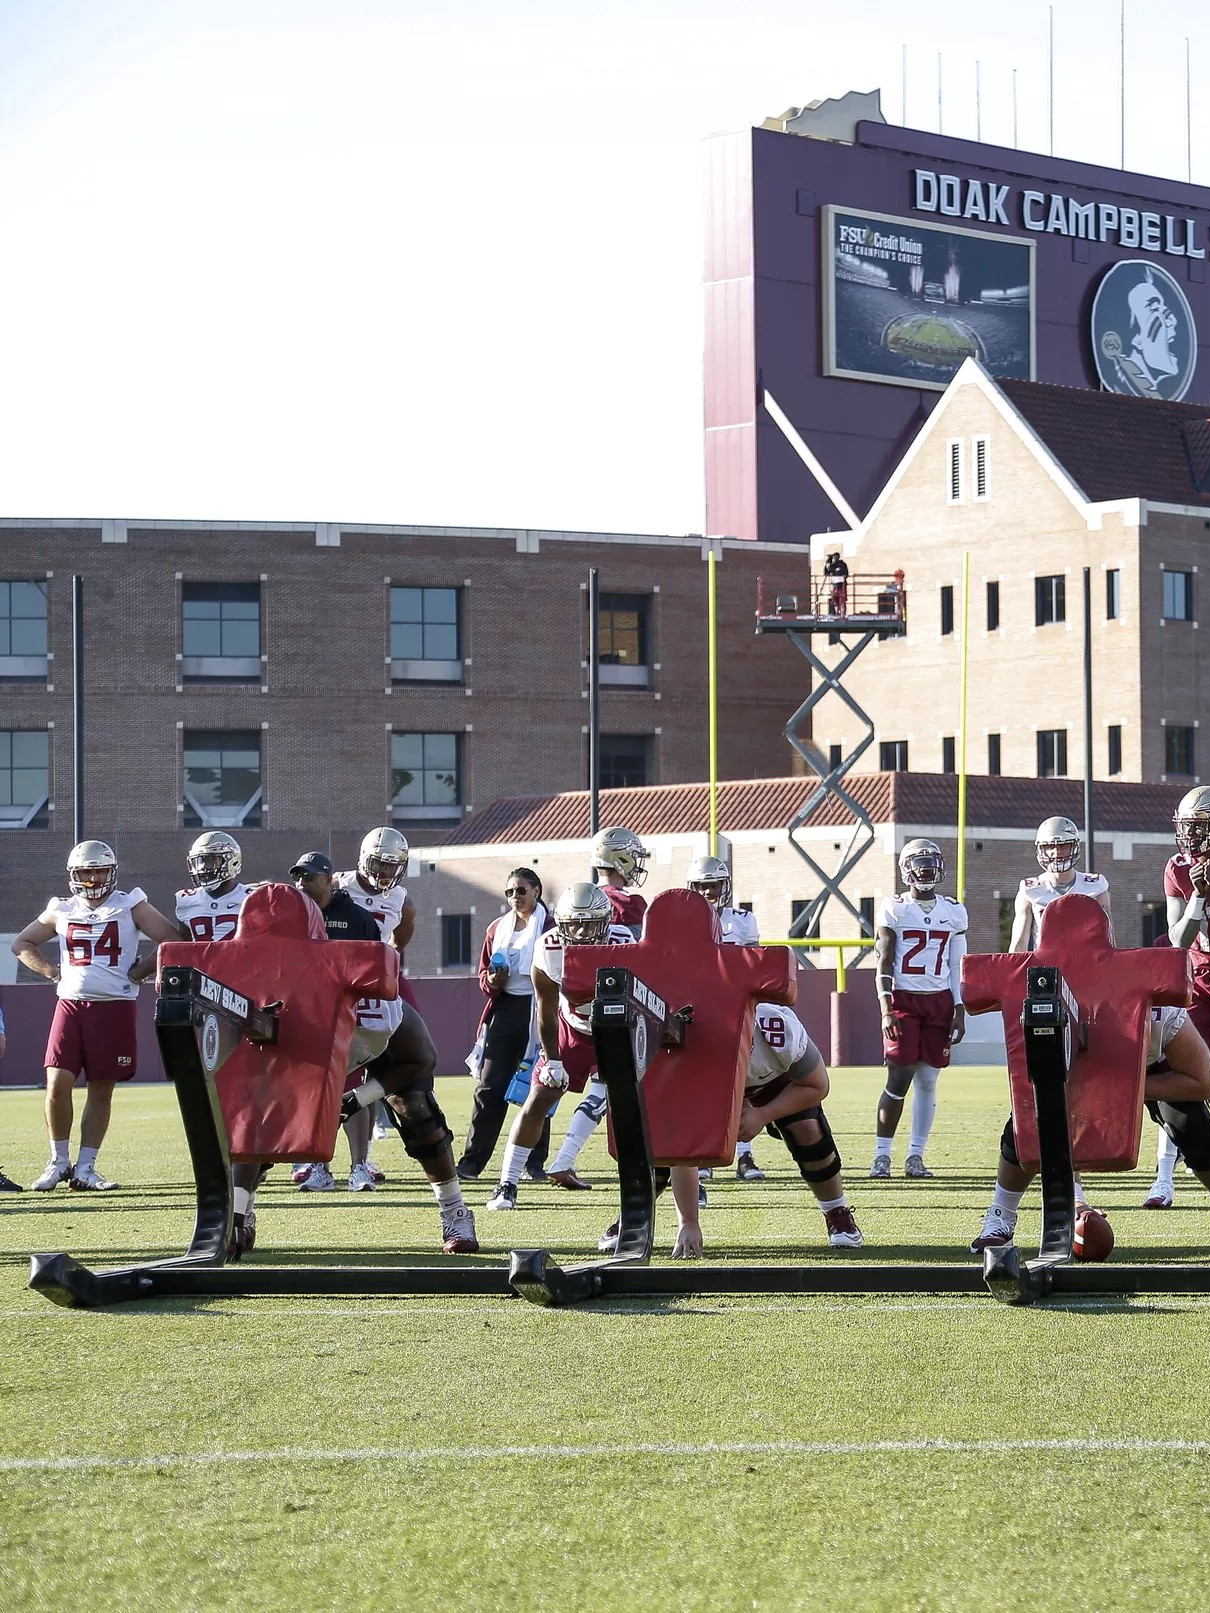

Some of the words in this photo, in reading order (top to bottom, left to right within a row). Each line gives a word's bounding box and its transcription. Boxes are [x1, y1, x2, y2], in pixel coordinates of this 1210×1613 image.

[914, 169, 1011, 225] DOAK
[1022, 190, 1206, 259] CAMPBELL
[839, 225, 867, 244] FSU
[874, 232, 899, 251] Credit
[899, 236, 923, 255] Union
[840, 242, 854, 254] THE
[66, 920, 122, 967] 64
[902, 930, 949, 976] 27
